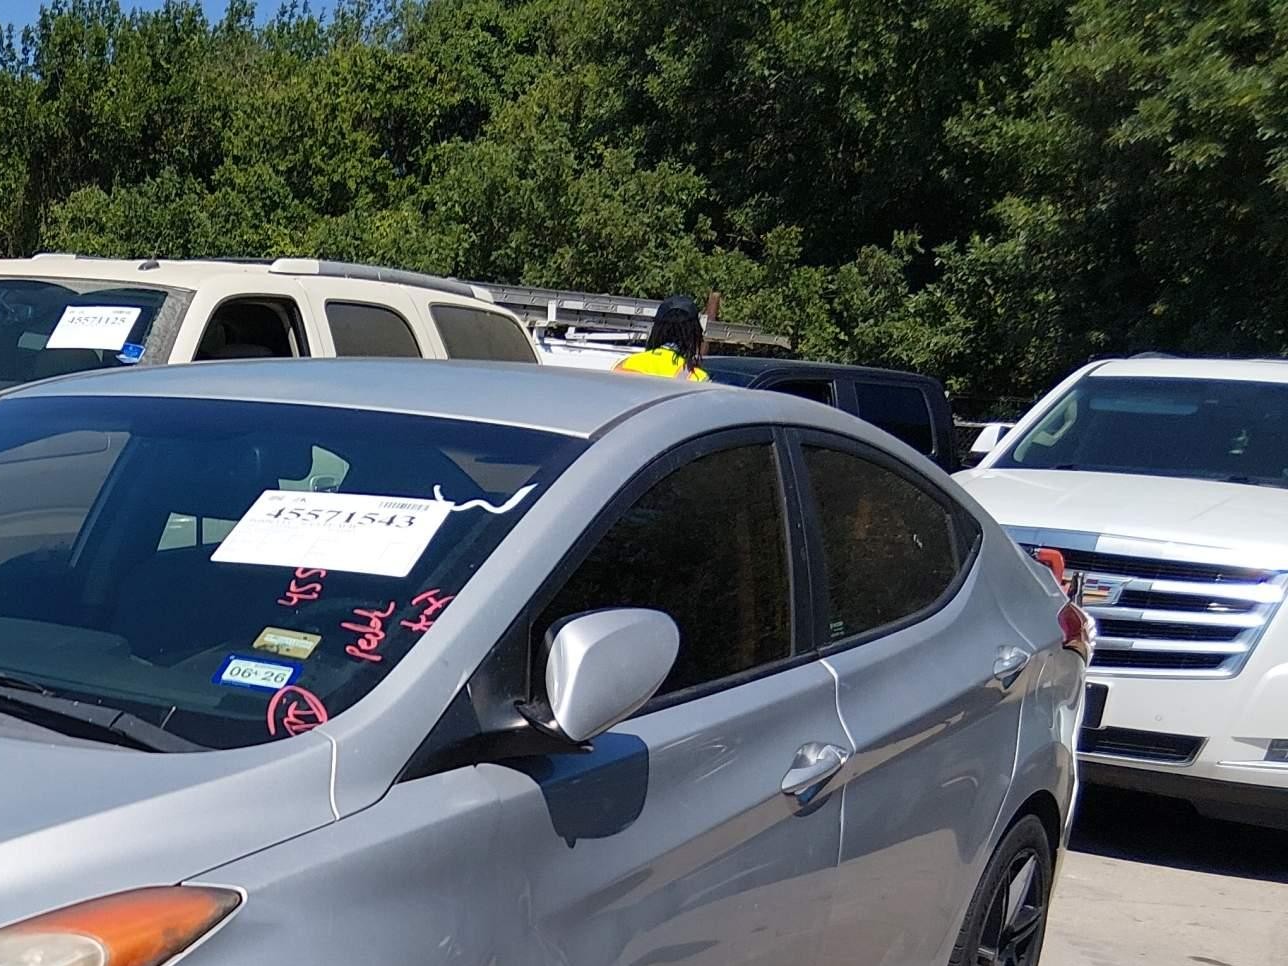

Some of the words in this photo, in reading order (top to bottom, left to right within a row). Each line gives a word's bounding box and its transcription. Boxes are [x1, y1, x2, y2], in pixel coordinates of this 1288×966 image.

[265, 506, 417, 528] 45571543
[229, 666, 252, 679] 06
[261, 670, 287, 683] 26
